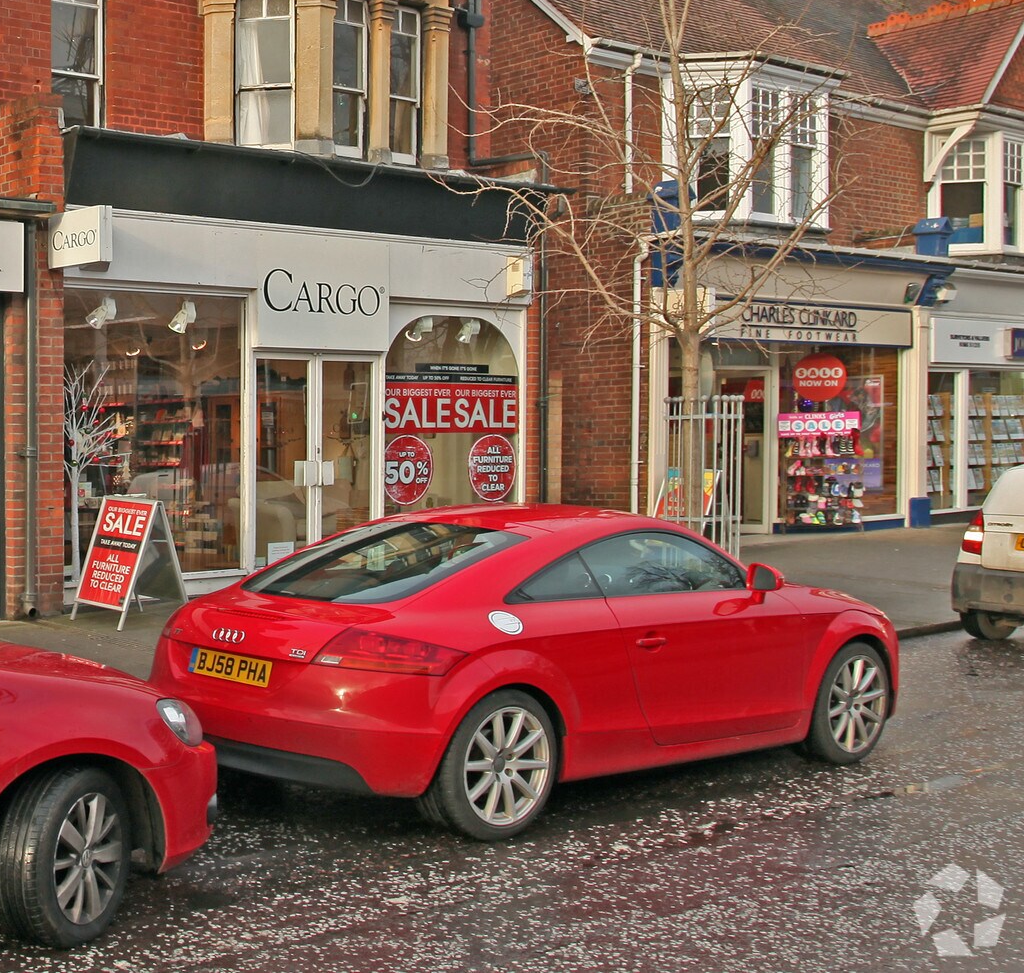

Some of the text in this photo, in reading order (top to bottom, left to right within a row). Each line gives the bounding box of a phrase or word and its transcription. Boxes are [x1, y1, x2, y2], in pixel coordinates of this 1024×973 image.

[741, 305, 857, 327] CHARLES CLINKARD
[740, 328, 858, 342] FINE FOOTWEAR
[796, 368, 842, 377] SALE
[799, 379, 838, 387] NOW ON
[403, 389, 433, 397] BIGGEST
[434, 389, 451, 397] EVER
[455, 389, 471, 397] OUR
[500, 390, 516, 398] EVER
[385, 398, 516, 428] SALE SALE
[794, 421, 843, 430] SALE
[487, 446, 501, 454] ALL
[477, 465, 510, 473] REDUCED
[103, 512, 146, 536] SALE
[122, 541, 137, 549] TODAY
[106, 554, 119, 563] ALL
[92, 560, 131, 575] FURNITURE
[92, 570, 125, 583] REDUCED
[90, 579, 122, 593] TO CLEAR
[290, 648, 306, 656] TDI
[197, 651, 267, 683] BJ58 PHA
